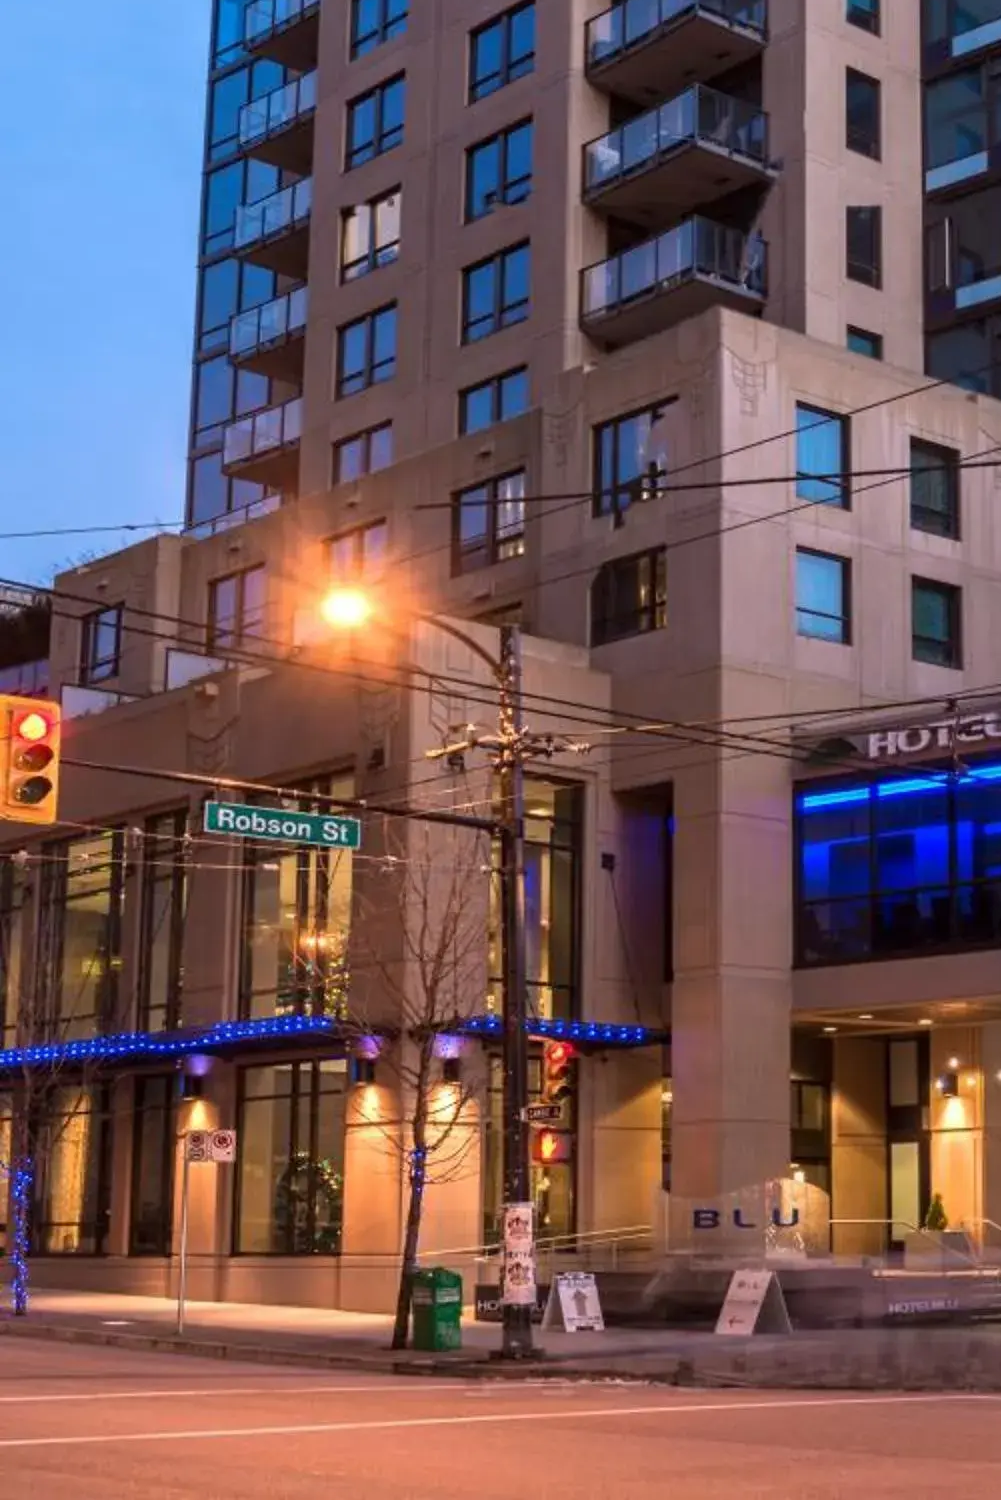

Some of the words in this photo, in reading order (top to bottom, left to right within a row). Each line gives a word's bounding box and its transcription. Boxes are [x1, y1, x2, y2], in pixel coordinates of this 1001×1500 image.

[217, 808, 311, 838] Robson
[322, 820, 348, 842] St
[693, 1208, 799, 1229] BLU
